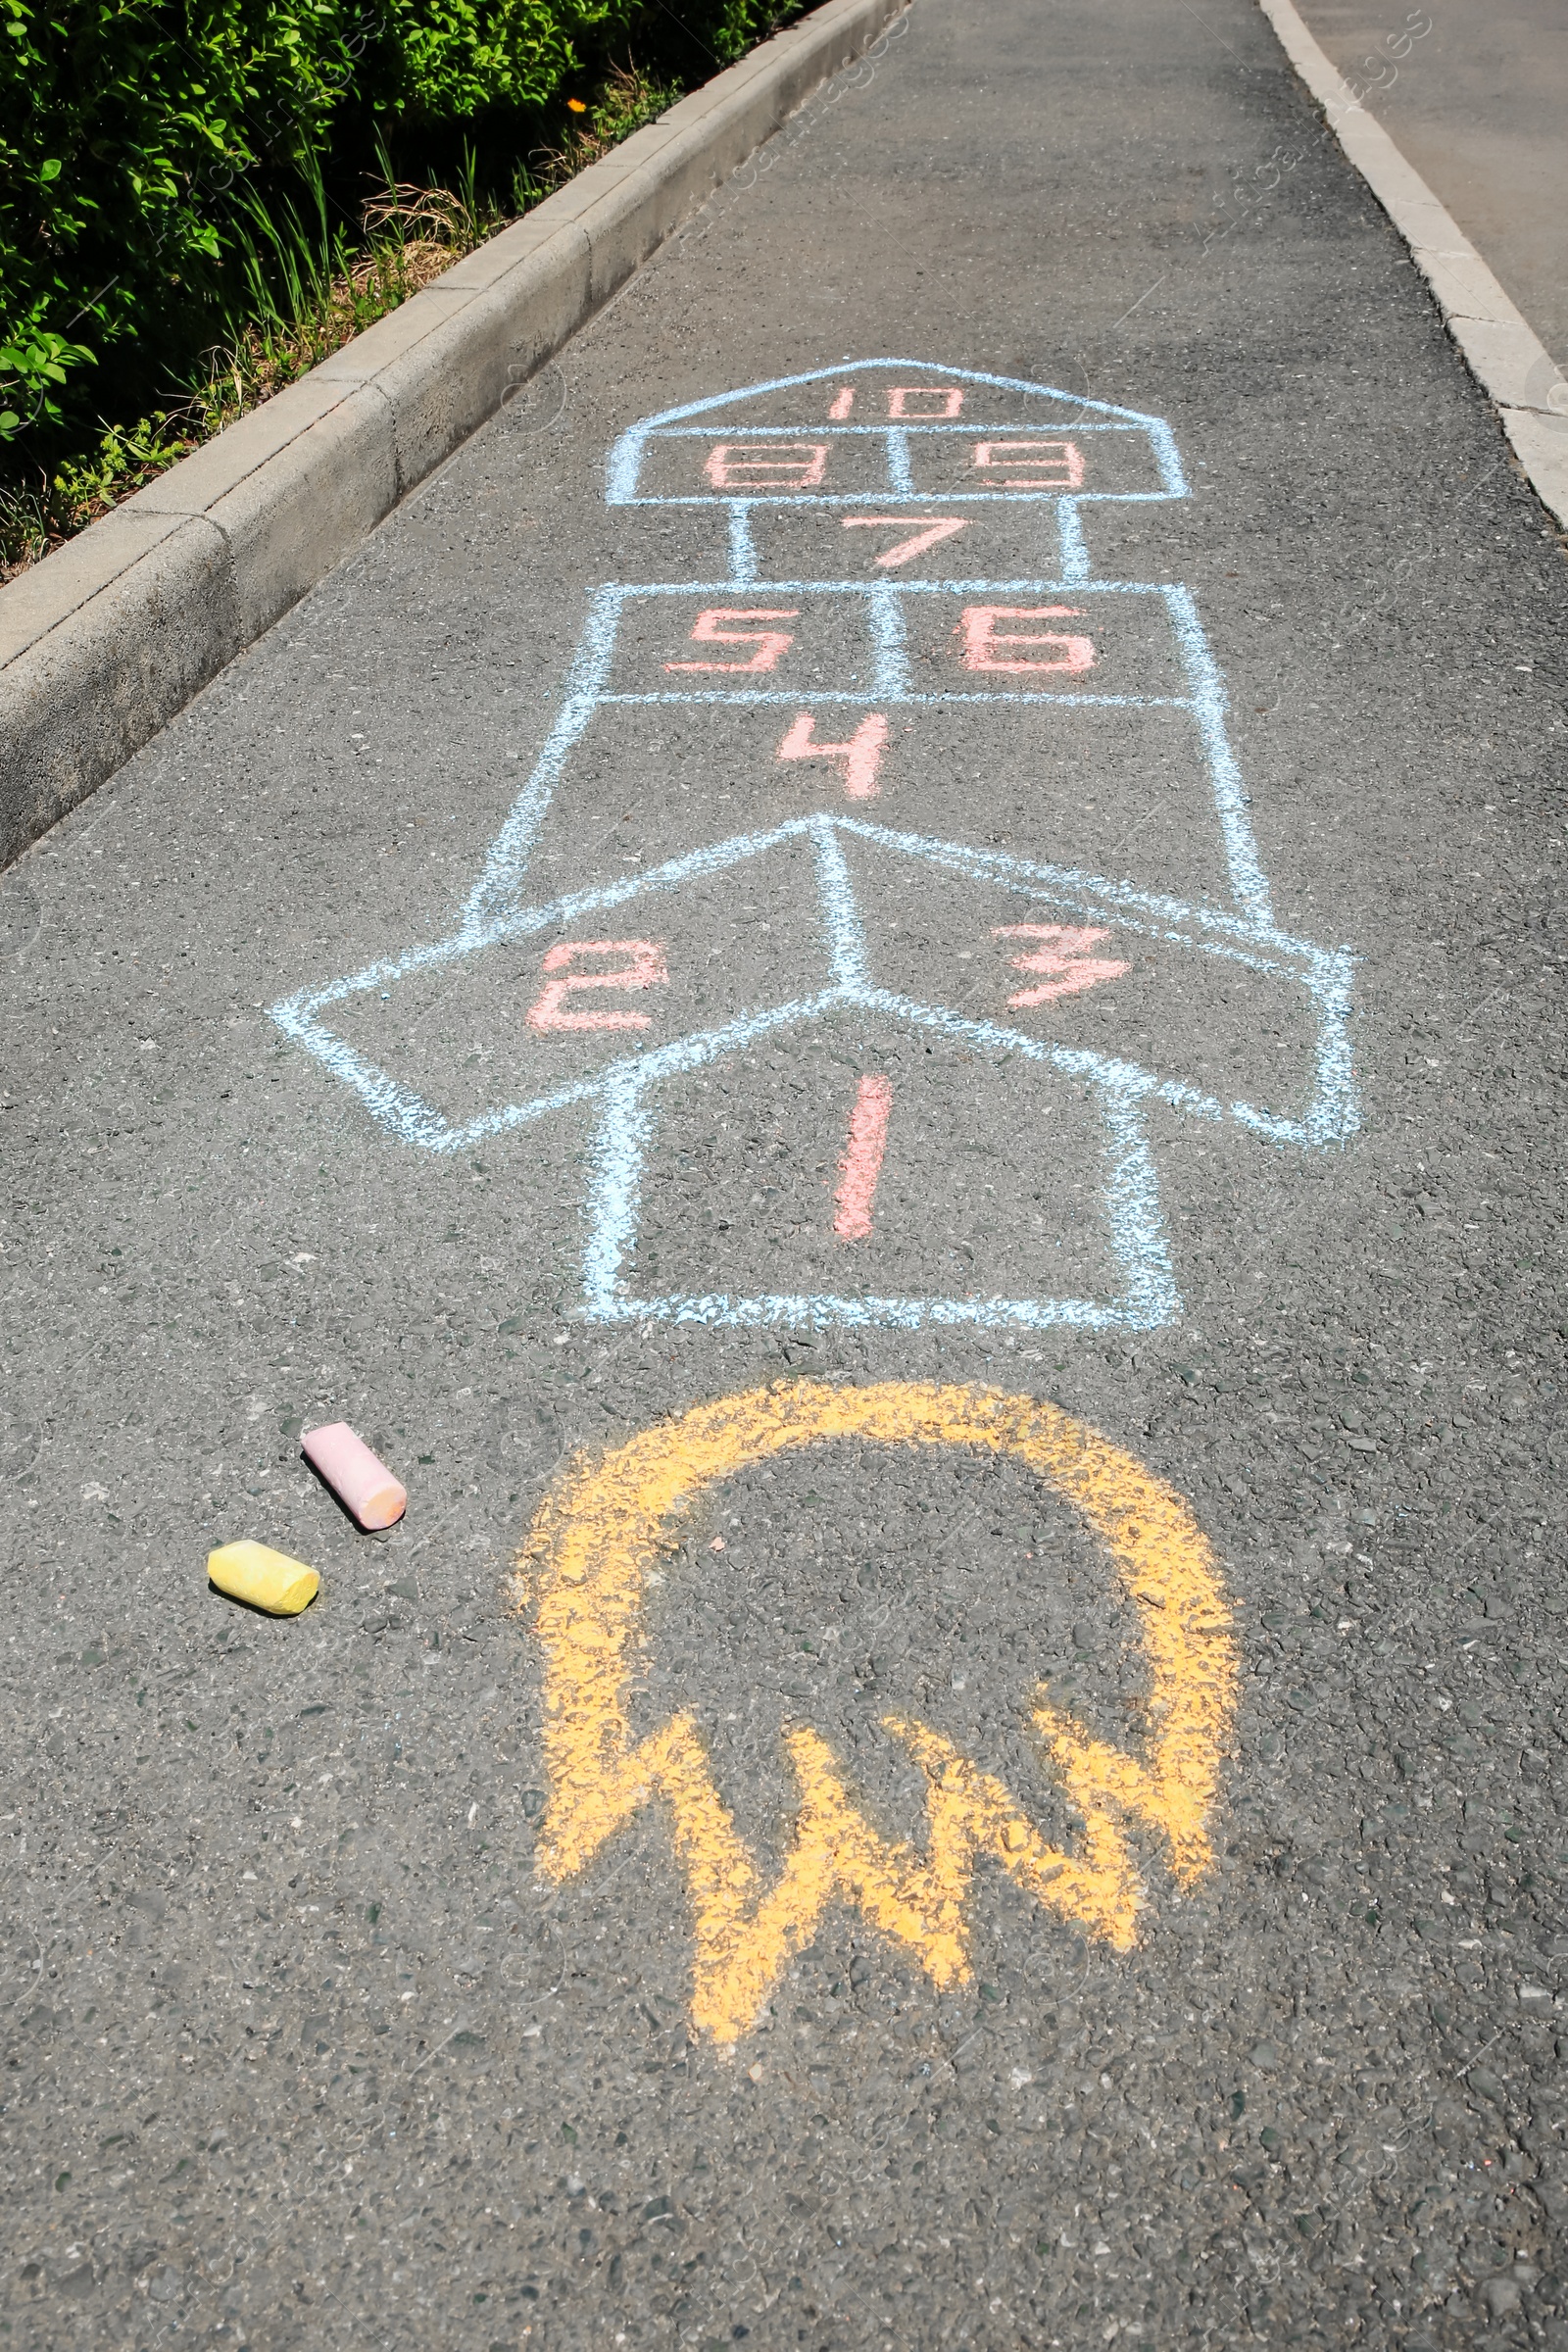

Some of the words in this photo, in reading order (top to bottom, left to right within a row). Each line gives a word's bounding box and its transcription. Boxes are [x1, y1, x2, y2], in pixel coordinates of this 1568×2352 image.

[828, 385, 965, 421] 10
[704, 443, 830, 489] 8
[973, 440, 1086, 488] 9
[842, 515, 970, 567] 7
[663, 607, 800, 672] 5
[956, 604, 1097, 674] 6
[776, 711, 889, 799] 4
[525, 940, 668, 1031] 2
[992, 923, 1130, 1009] 3
[833, 1074, 893, 1243] 1
